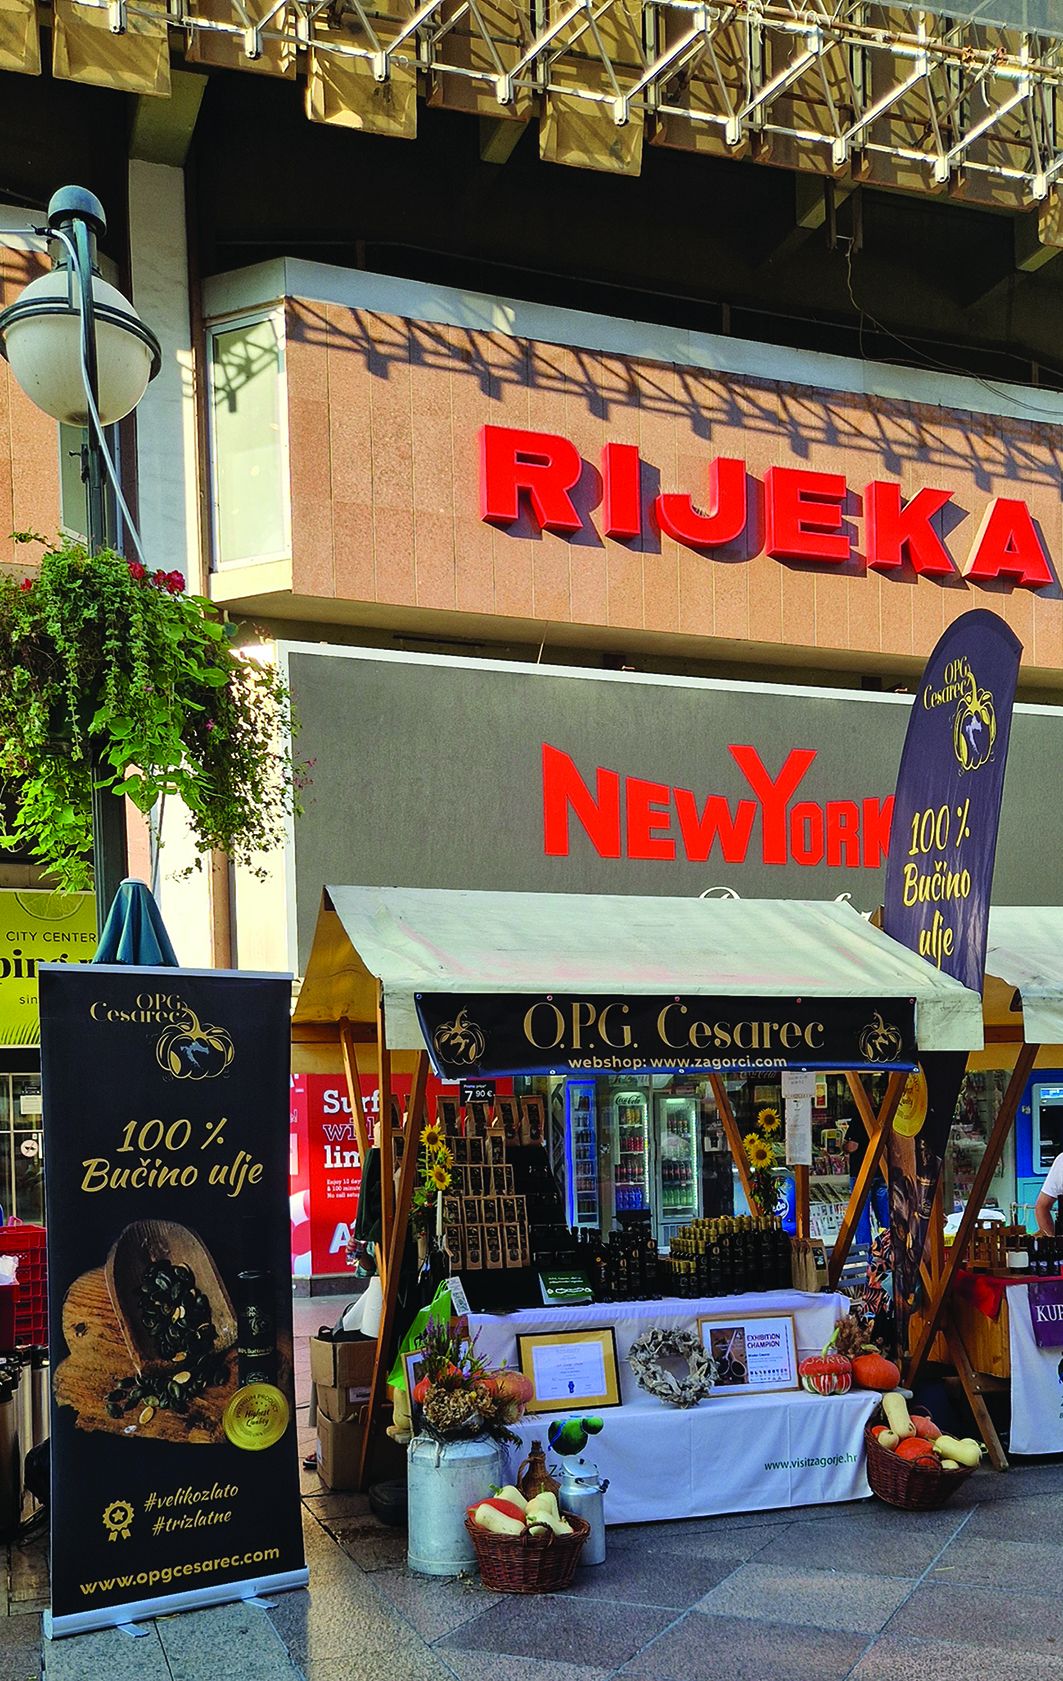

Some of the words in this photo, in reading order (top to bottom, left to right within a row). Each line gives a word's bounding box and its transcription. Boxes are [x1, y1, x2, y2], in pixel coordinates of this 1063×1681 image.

[480, 423, 1054, 586] RIJEKA
[944, 655, 969, 684] OPG
[922, 678, 969, 711] Cesarec
[908, 804, 950, 857] 100
[956, 798, 971, 848] %
[902, 860, 972, 908] Bučino
[6, 930, 37, 942] CITY
[42, 931, 97, 943] CENTER
[918, 909, 955, 971] ulje
[90, 1001, 183, 1023] Cesarec
[136, 993, 182, 1011] OPG
[523, 1002, 639, 1050] O.P.G.
[656, 1002, 825, 1050] Cesarec
[568, 1057, 647, 1071] webshop:
[650, 1056, 787, 1070] www.zagorci.com
[464, 1090, 473, 1102] 7
[116, 1119, 192, 1153] 100
[200, 1117, 228, 1150] %
[80, 1157, 199, 1193] Bučino
[208, 1150, 264, 1198] ulje
[764, 1452, 858, 1471] www.visitzagorje.hr
[143, 1482, 239, 1513] #velikozlato
[151, 1509, 232, 1537] #trizlatne
[79, 1547, 280, 1596] www.opgcesarec.com
